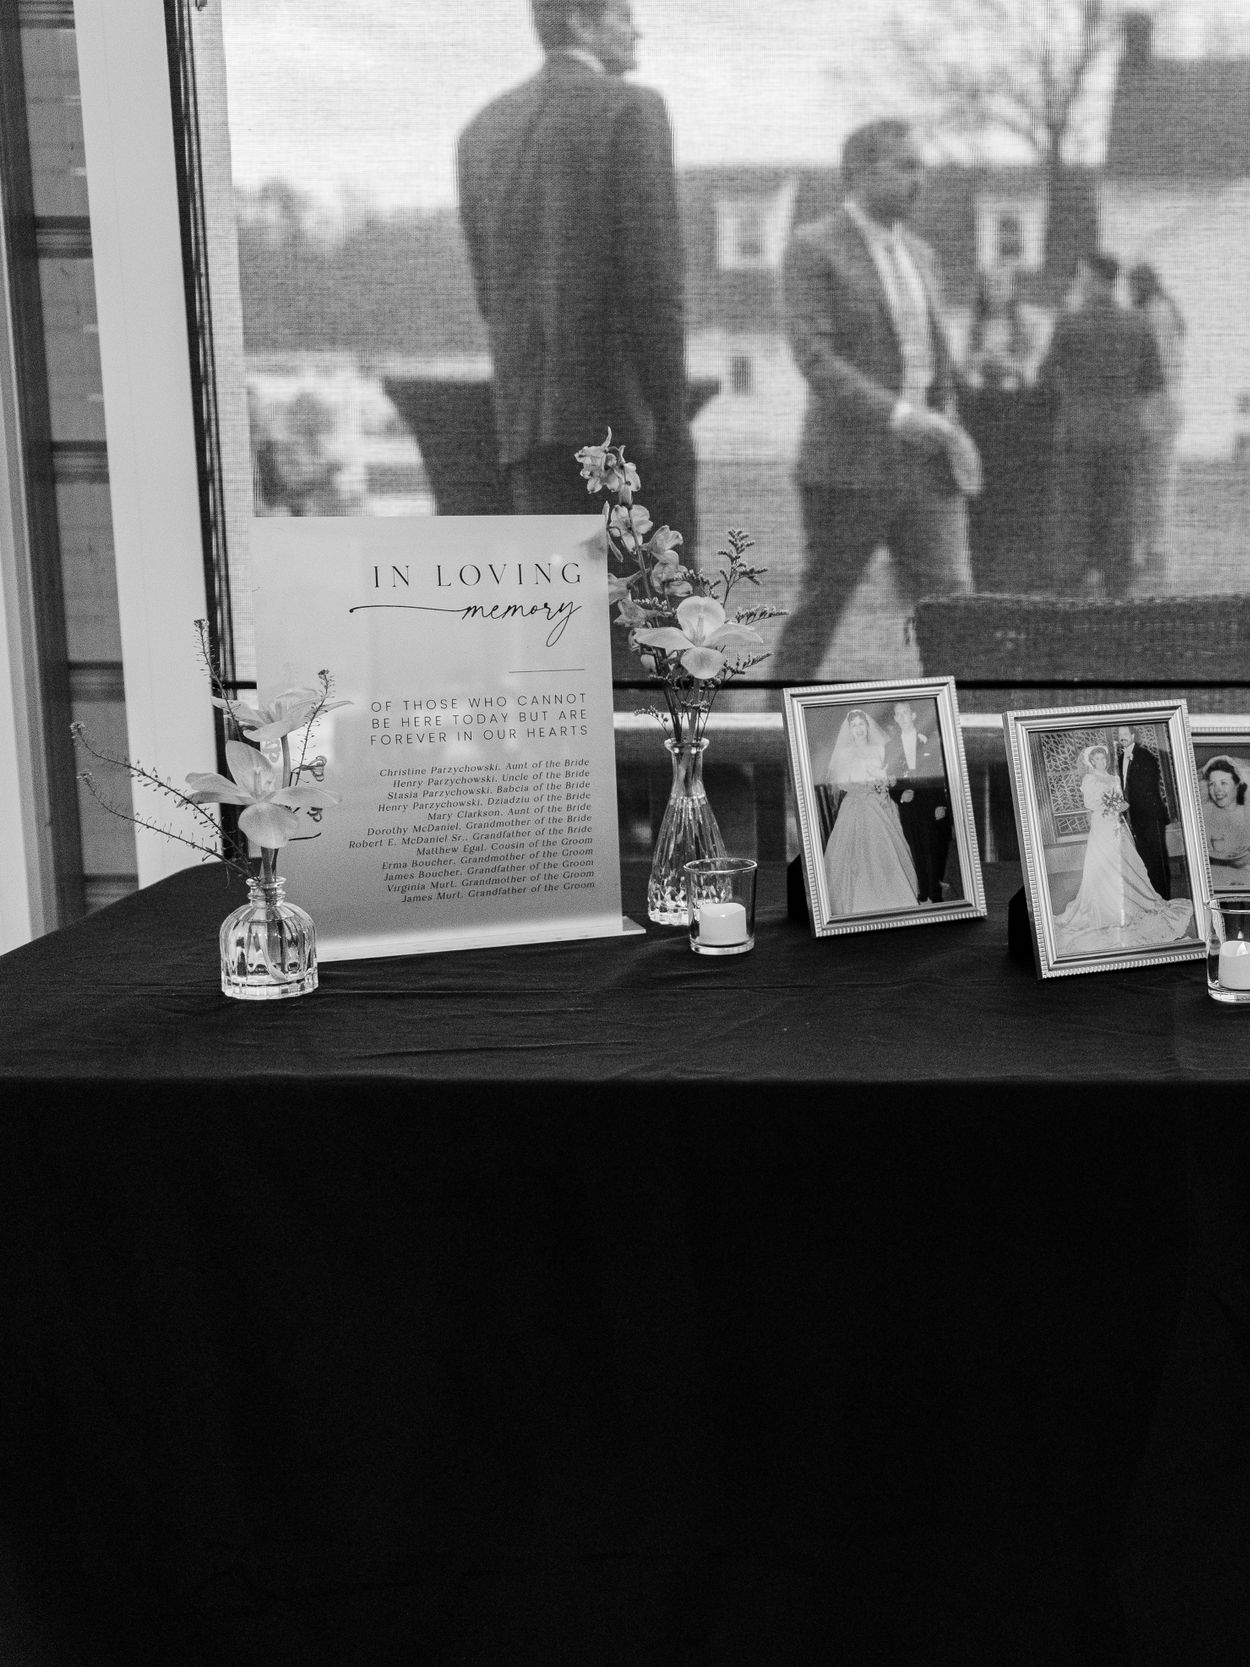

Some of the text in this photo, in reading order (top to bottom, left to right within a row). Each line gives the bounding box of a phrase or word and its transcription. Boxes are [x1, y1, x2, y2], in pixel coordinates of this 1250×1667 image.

[373, 562, 582, 588] IN LOVING
[349, 600, 583, 647] memory
[370, 693, 587, 712] OF THOSE WHO CANNOT
[372, 709, 587, 729] BE HERE TODAY BUT ARE
[370, 725, 588, 746] FOREVER IN OUR HEARTS
[379, 767, 427, 777] Christine
[505, 762, 528, 770] Aunt
[531, 760, 543, 769] of
[545, 760, 561, 768] the
[564, 758, 590, 767] Bride
[393, 779, 424, 788] Henry
[502, 773, 529, 782] Uncle
[532, 771, 544, 780] of
[546, 771, 561, 779] the
[564, 769, 590, 778] Bride
[387, 791, 418, 800] Stasia
[496, 784, 529, 794] Babcia
[532, 783, 544, 791] of
[546, 782, 562, 790] the
[565, 781, 591, 789] Bride
[378, 803, 408, 813] Henry
[487, 796, 530, 806] Dziadziu
[533, 794, 544, 803] of
[546, 793, 562, 802] the
[565, 792, 591, 801] Bride
[427, 812, 453, 821] Mary
[507, 807, 530, 816] Aunt
[534, 805, 545, 814] of
[547, 804, 563, 813] the
[566, 803, 592, 812] Bride
[367, 826, 408, 836] Dorothy
[465, 819, 531, 830] Grandmother
[534, 816, 546, 825] of
[548, 816, 564, 824] the
[566, 814, 592, 823] Bride
[349, 839, 383, 849] Robert
[388, 838, 397, 846] E.
[401, 834, 448, 845] McDaniel
[472, 828, 531, 841] Grandfather
[535, 828, 546, 836] of
[548, 827, 564, 835] the
[567, 826, 593, 834] Bride
[416, 846, 459, 856] Matthew
[491, 841, 525, 851] Cousin
[528, 839, 540, 848] of
[542, 839, 558, 847] the
[561, 837, 593, 846] Groom
[382, 861, 408, 870] Erma
[460, 852, 526, 864] Grandmother
[529, 851, 540, 860] of
[542, 850, 558, 858] the
[561, 848, 594, 857] Groom
[384, 872, 415, 882] James
[466, 863, 526, 875] Grandfather
[529, 862, 541, 870] of
[543, 861, 559, 870] the
[562, 859, 594, 868] Groom
[387, 884, 426, 894] Virginia
[461, 875, 527, 887] Grandmother
[530, 874, 541, 882] of
[543, 873, 559, 881] the
[563, 870, 594, 879] Groom
[401, 895, 433, 903] James
[468, 886, 527, 898] Grandfather
[530, 885, 541, 893] of
[544, 884, 559, 892] the
[563, 881, 595, 890] Groom
